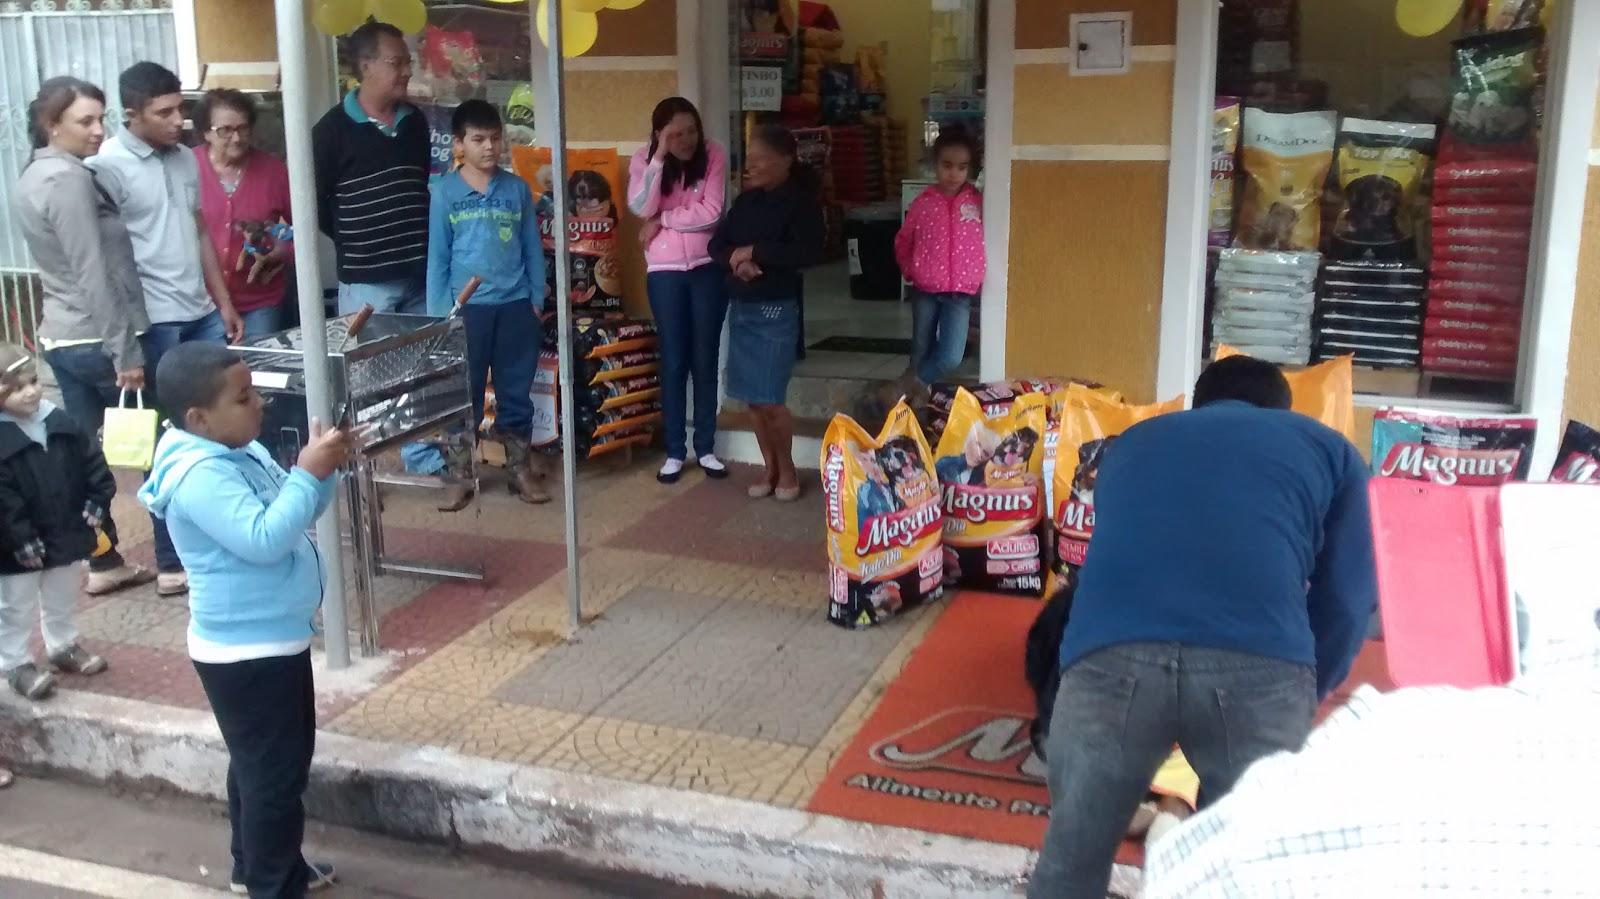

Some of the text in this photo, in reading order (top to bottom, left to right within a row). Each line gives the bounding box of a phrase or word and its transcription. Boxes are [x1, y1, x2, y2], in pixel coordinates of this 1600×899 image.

[539, 216, 611, 241] Mgnus
[1381, 445, 1513, 486] Magnus
[824, 445, 844, 529] Magnus
[940, 483, 1034, 523] Magnus
[856, 502, 942, 556] Magnus
[991, 540, 1036, 555] Adultos
[847, 773, 1050, 817] Alimento Pr
